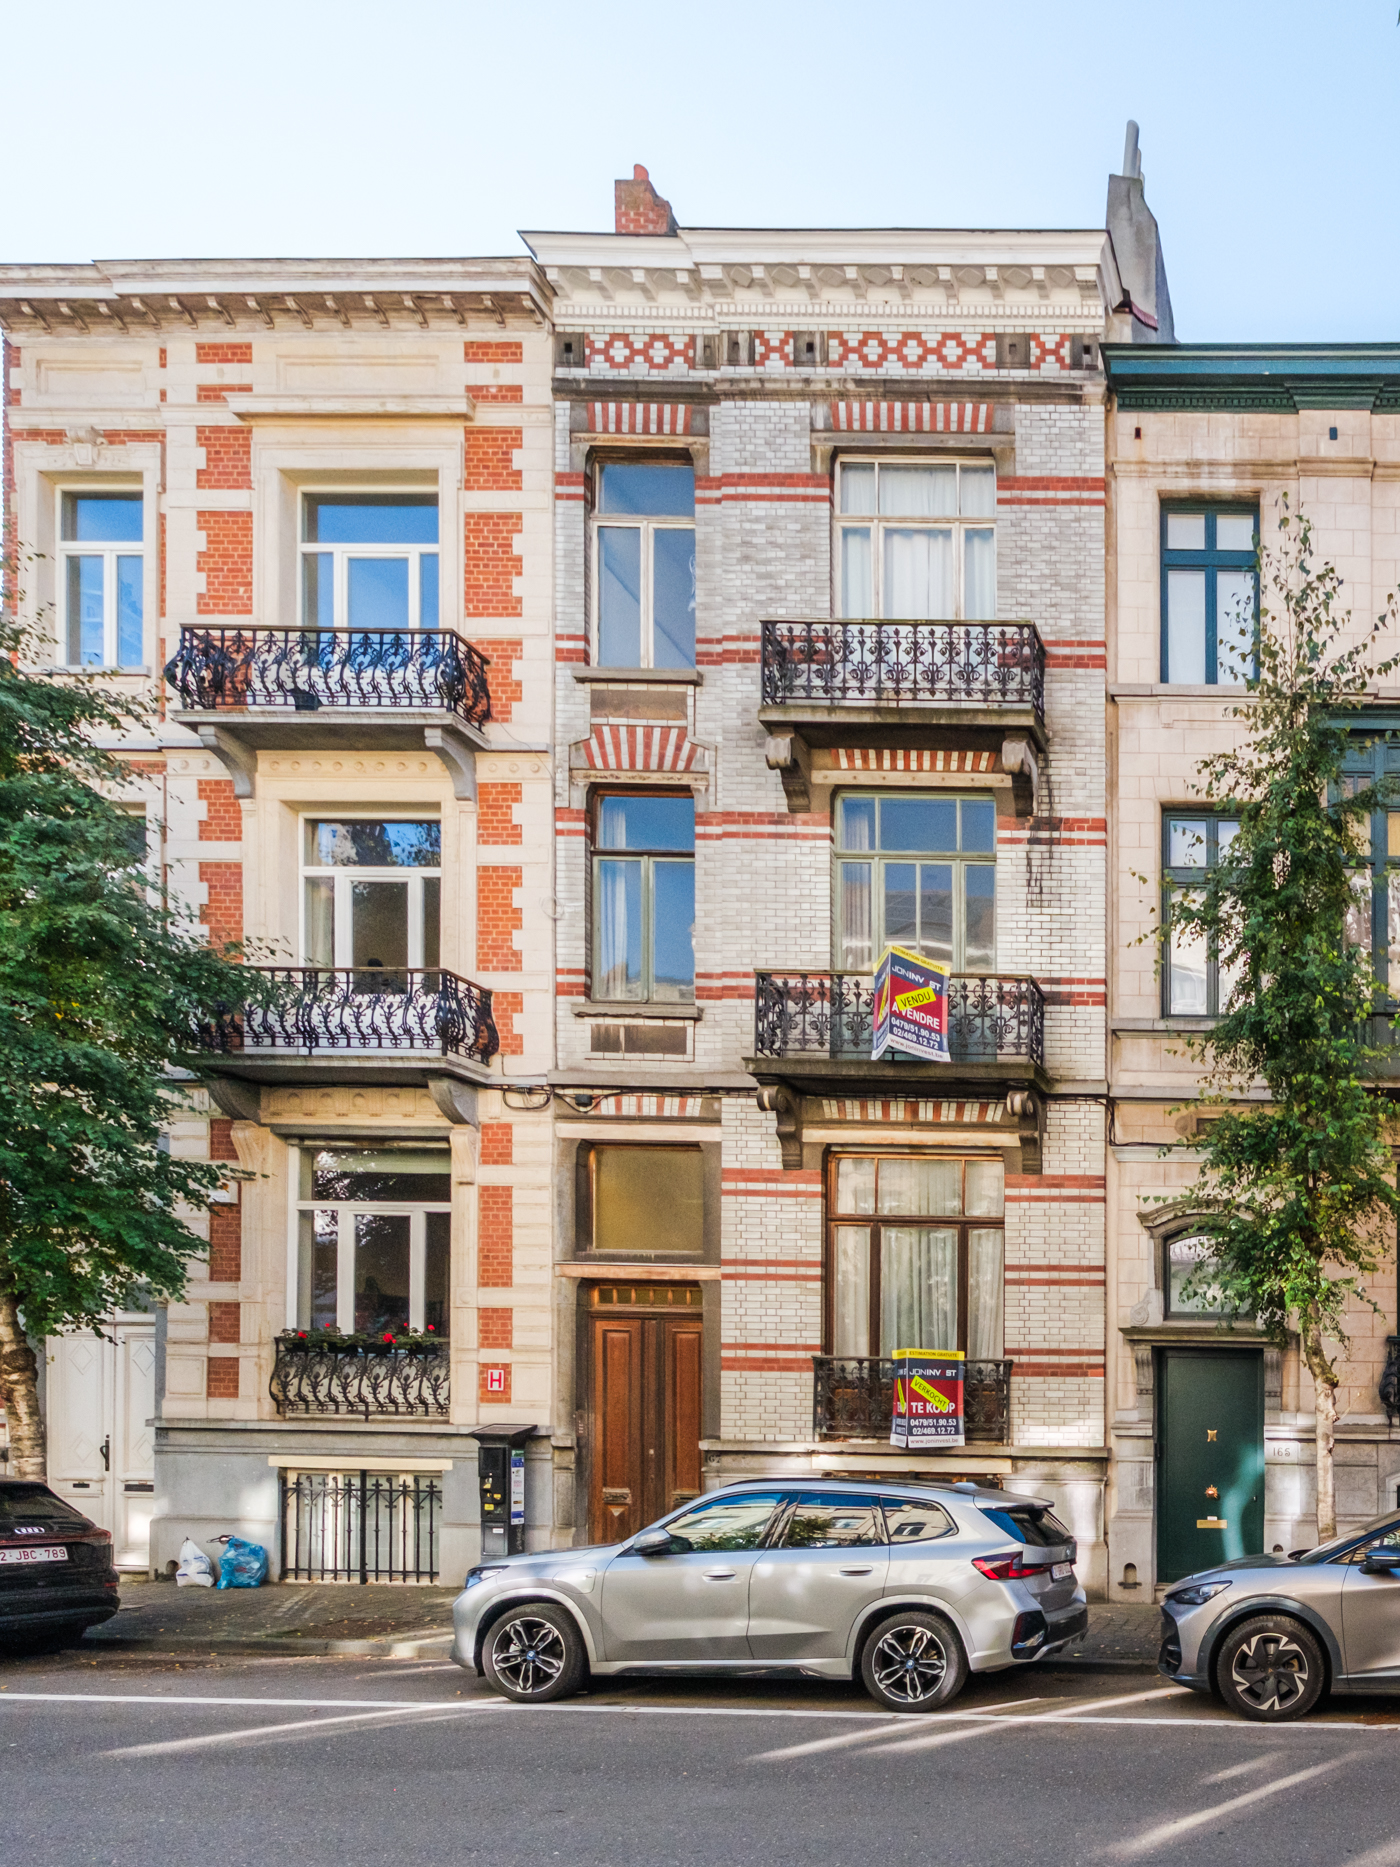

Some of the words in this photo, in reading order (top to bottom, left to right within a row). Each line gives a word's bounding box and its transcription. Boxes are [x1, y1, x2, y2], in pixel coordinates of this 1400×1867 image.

[892, 946, 920, 961] ESTIMATION
[920, 957, 943, 972] GRATUITE
[900, 991, 931, 1007] VENDU
[891, 1001, 899, 1014] A
[901, 1008, 940, 1030] VENDRE
[891, 1017, 940, 1041] 0479/51.90.53
[893, 1027, 939, 1050] 02/469.12.72
[890, 1038, 944, 1059] www.joninvest.be
[490, 1372, 502, 1388] H
[914, 1379, 947, 1407] VERKOCHT
[910, 1402, 924, 1414] TE
[910, 1418, 957, 1426] 0479/51.90.53
[912, 1427, 955, 1435] 02/469.12.72
[1273, 1447, 1291, 1457] 165
